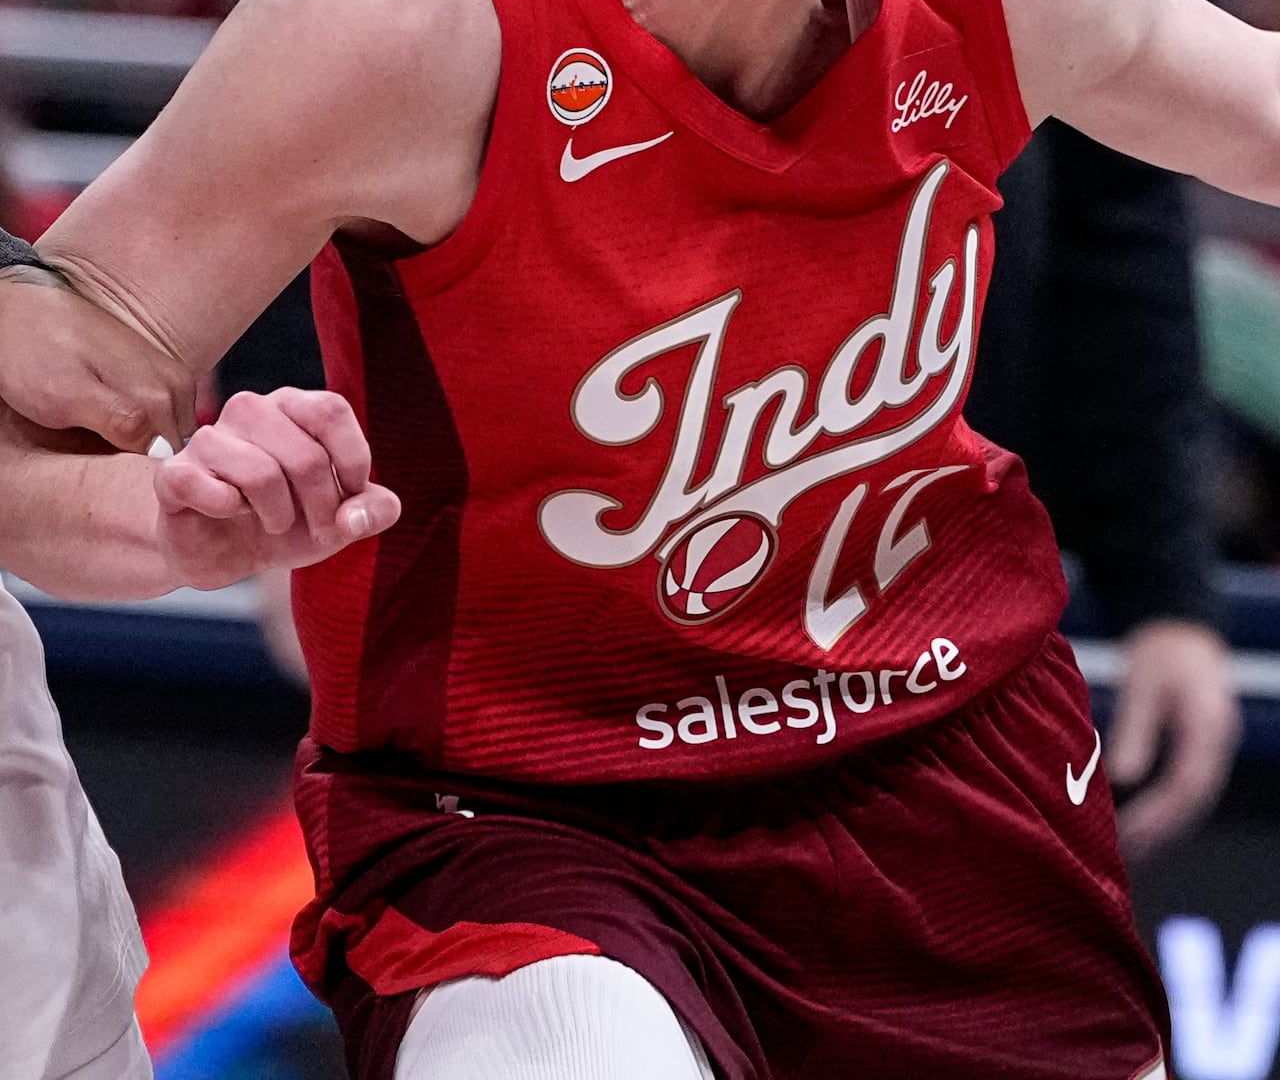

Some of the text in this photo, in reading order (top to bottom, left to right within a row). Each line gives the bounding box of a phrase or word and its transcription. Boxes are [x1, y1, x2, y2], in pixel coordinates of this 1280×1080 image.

[891, 70, 968, 133] Lilly
[537, 159, 979, 568] Indy
[635, 637, 968, 750] salesforce
